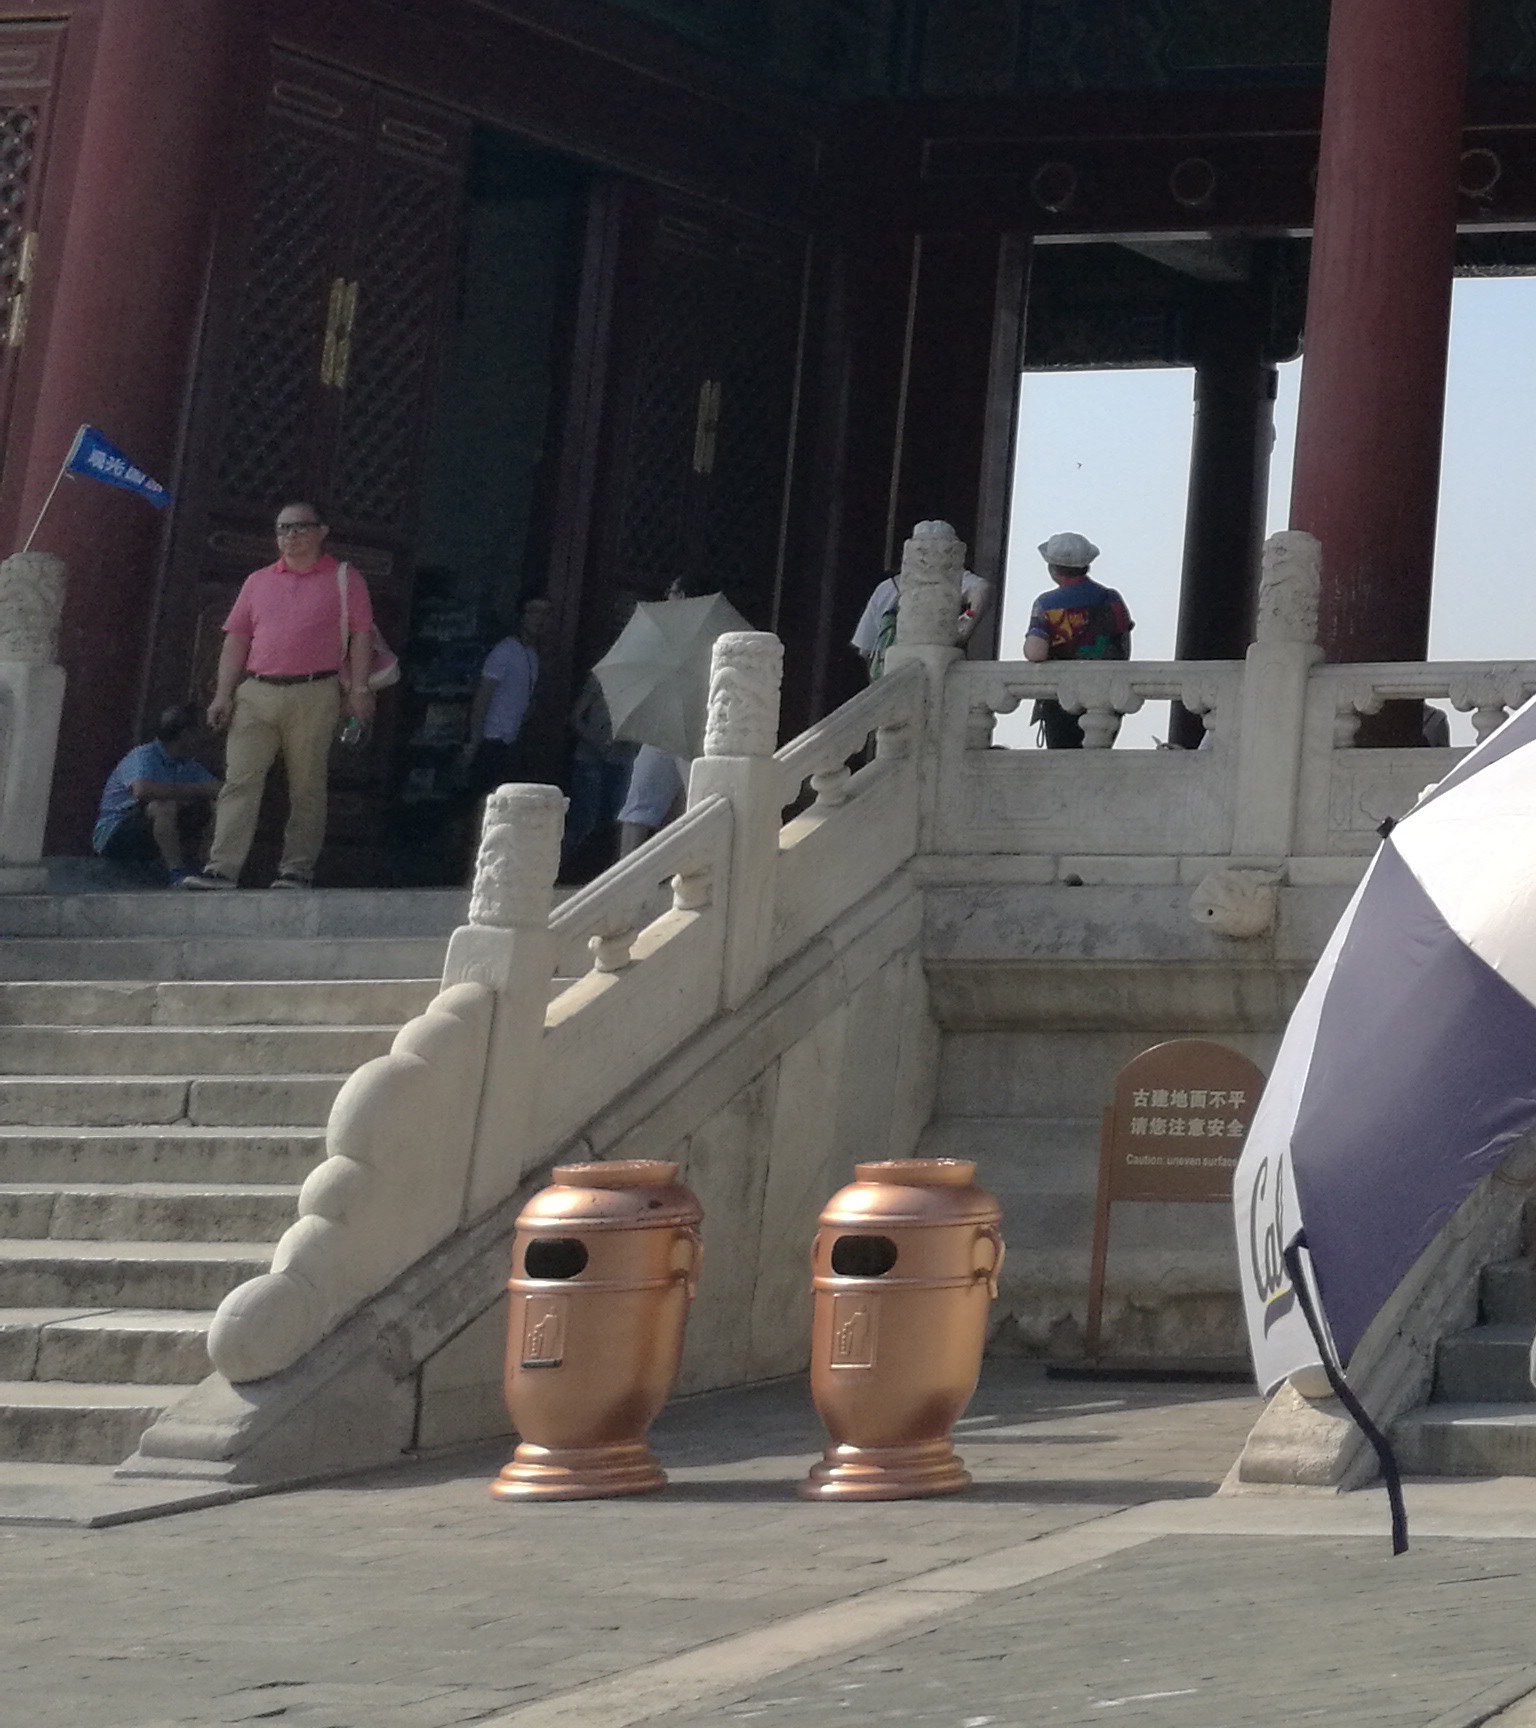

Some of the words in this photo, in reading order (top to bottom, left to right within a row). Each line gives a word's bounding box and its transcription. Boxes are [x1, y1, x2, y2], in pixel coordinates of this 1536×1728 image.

[1132, 1088, 1246, 1109] 古建地面不平
[1130, 1117, 1245, 1138] 请您注意安全
[1167, 1156, 1201, 1167] uneven
